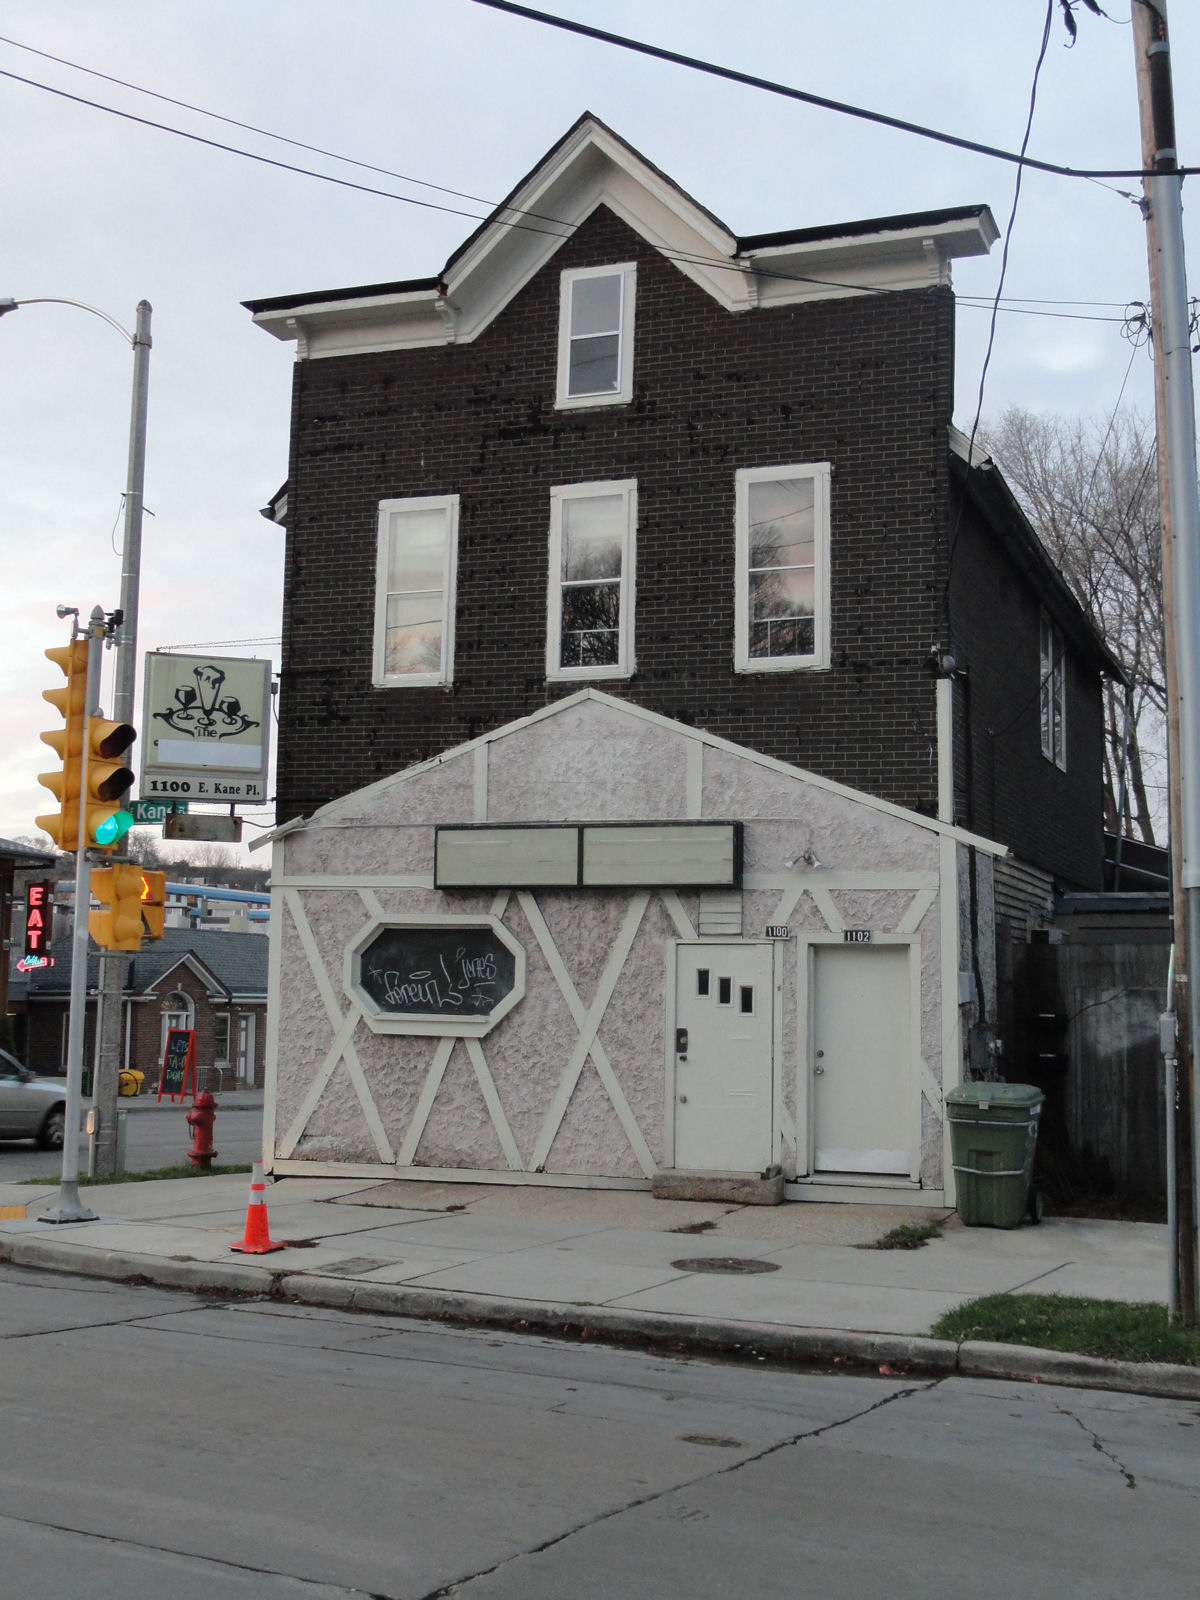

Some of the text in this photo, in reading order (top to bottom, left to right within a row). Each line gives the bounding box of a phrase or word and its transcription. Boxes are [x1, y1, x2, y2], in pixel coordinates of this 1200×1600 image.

[194, 725, 218, 738] The
[150, 780, 191, 793] 1100
[198, 782, 209, 793] E.
[214, 783, 241, 795] Kane
[27, 886, 44, 949] EAT
[767, 926, 788, 938] 1100
[845, 931, 870, 942] 1102
